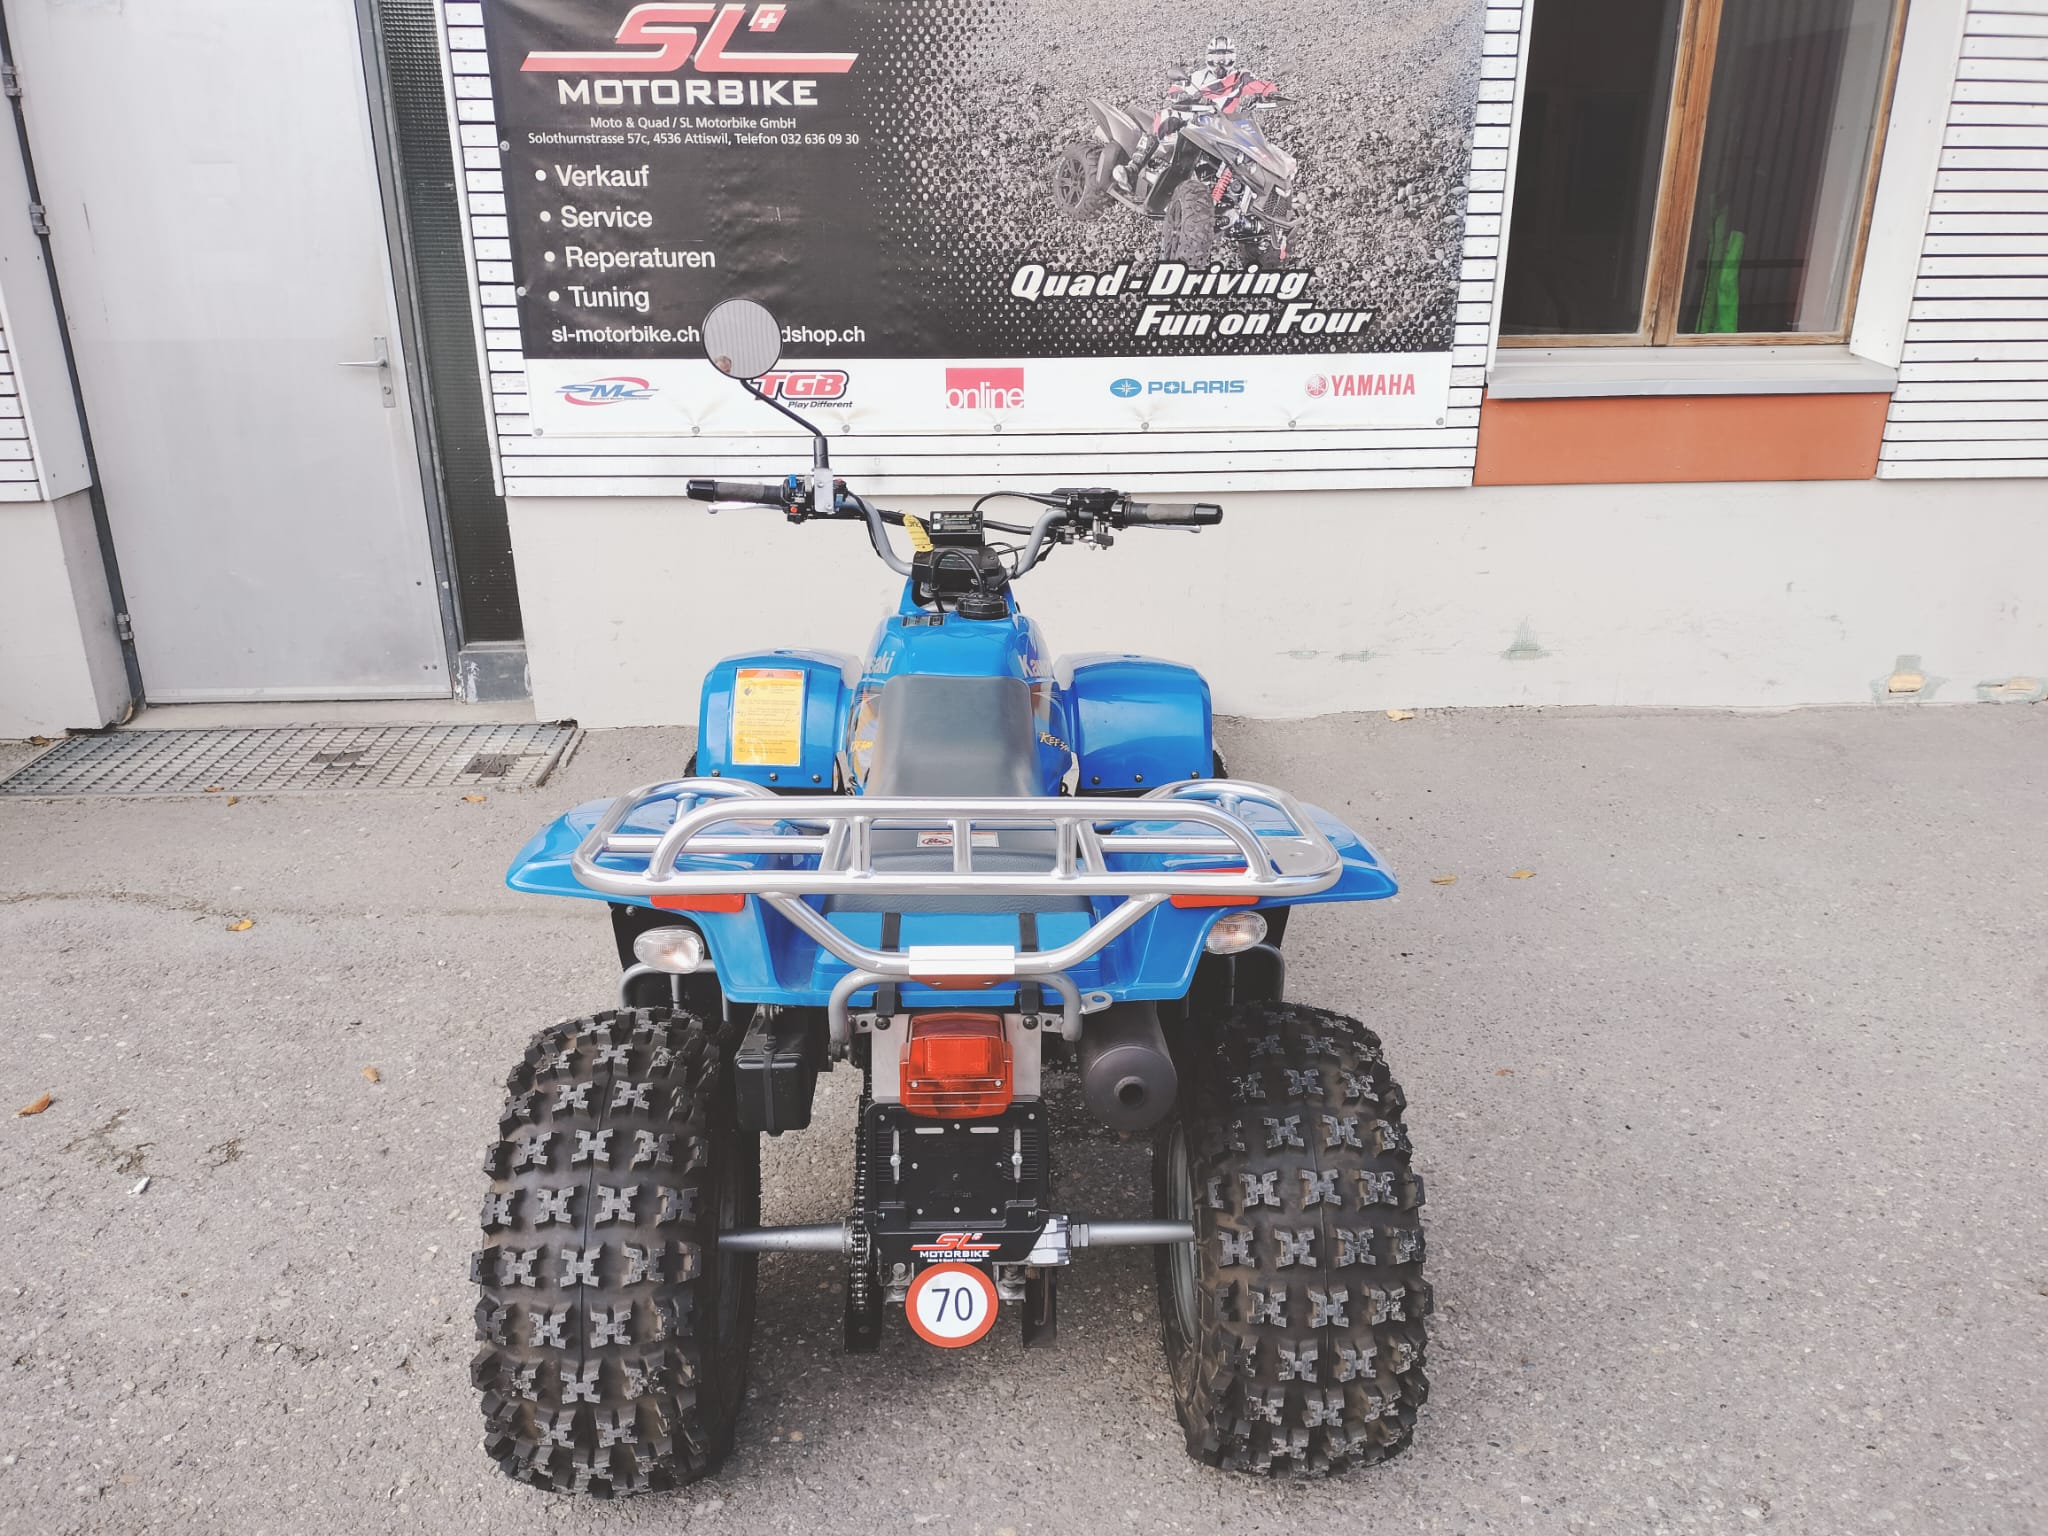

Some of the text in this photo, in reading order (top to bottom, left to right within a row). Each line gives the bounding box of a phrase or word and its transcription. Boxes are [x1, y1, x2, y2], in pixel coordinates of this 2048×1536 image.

[520, 3, 860, 73] SL
[557, 79, 818, 106] MOTORBIKE
[589, 116, 623, 129] Moto
[625, 116, 636, 129] &
[637, 116, 671, 130] Quad
[679, 116, 694, 129] SL
[695, 116, 758, 129] Motorbike
[759, 116, 797, 129] GmbH
[527, 132, 860, 146] Solothurnstrasse 57c, 4536 Attiswil, Telefon 032 636 09 30
[554, 164, 650, 187] Verkauf
[560, 205, 653, 228] Service
[564, 245, 716, 273] Reperaturen
[567, 285, 650, 313] Tuning
[1134, 302, 1374, 336] Fun on Four
[551, 325, 866, 346] sl-motorbike.ch dshop.ch
[757, 373, 846, 398] TGB
[945, 381, 1025, 408] online
[1146, 379, 1246, 395] POLARIS
[1330, 373, 1416, 397] YAMAHA
[787, 400, 854, 410] Play Different
[911, 1232, 1002, 1251] SL
[919, 1249, 991, 1258] MOTORBIKE
[931, 1286, 974, 1323] 70
